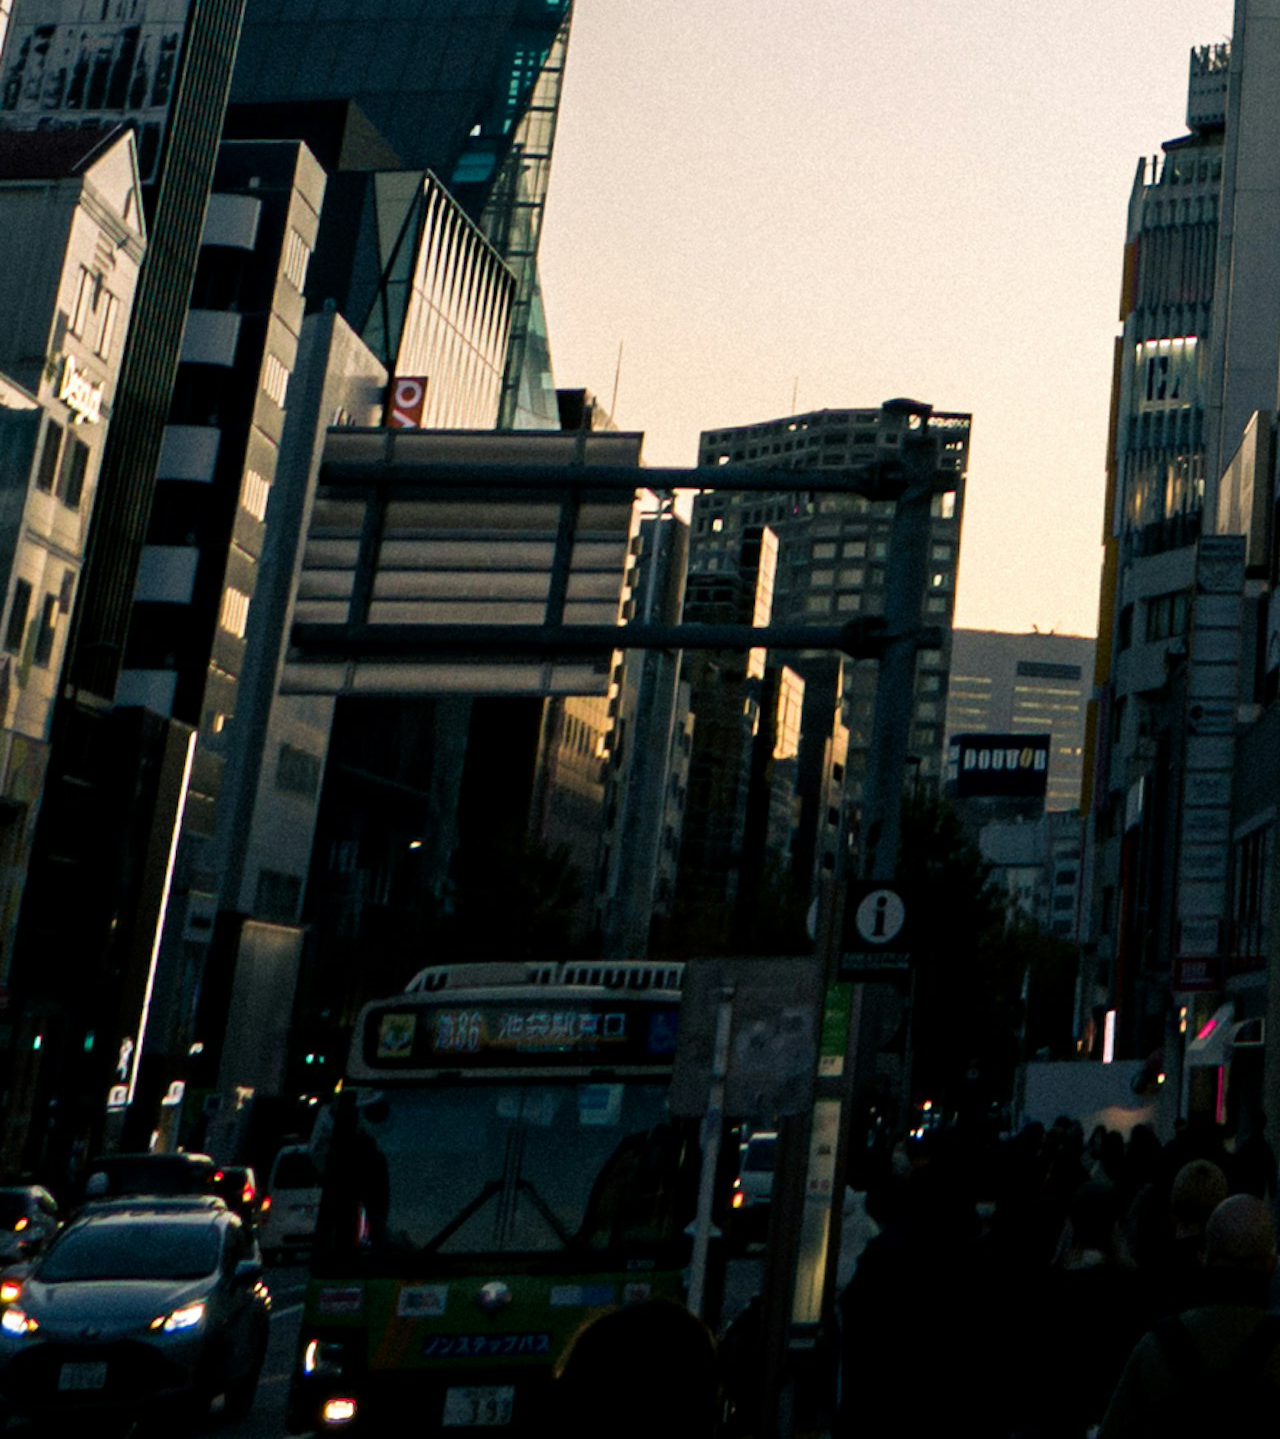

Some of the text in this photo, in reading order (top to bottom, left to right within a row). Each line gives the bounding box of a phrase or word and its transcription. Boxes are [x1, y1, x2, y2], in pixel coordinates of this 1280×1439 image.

[963, 746, 1048, 772] DOUTOR
[425, 1334, 551, 1356] ノンステップバス
